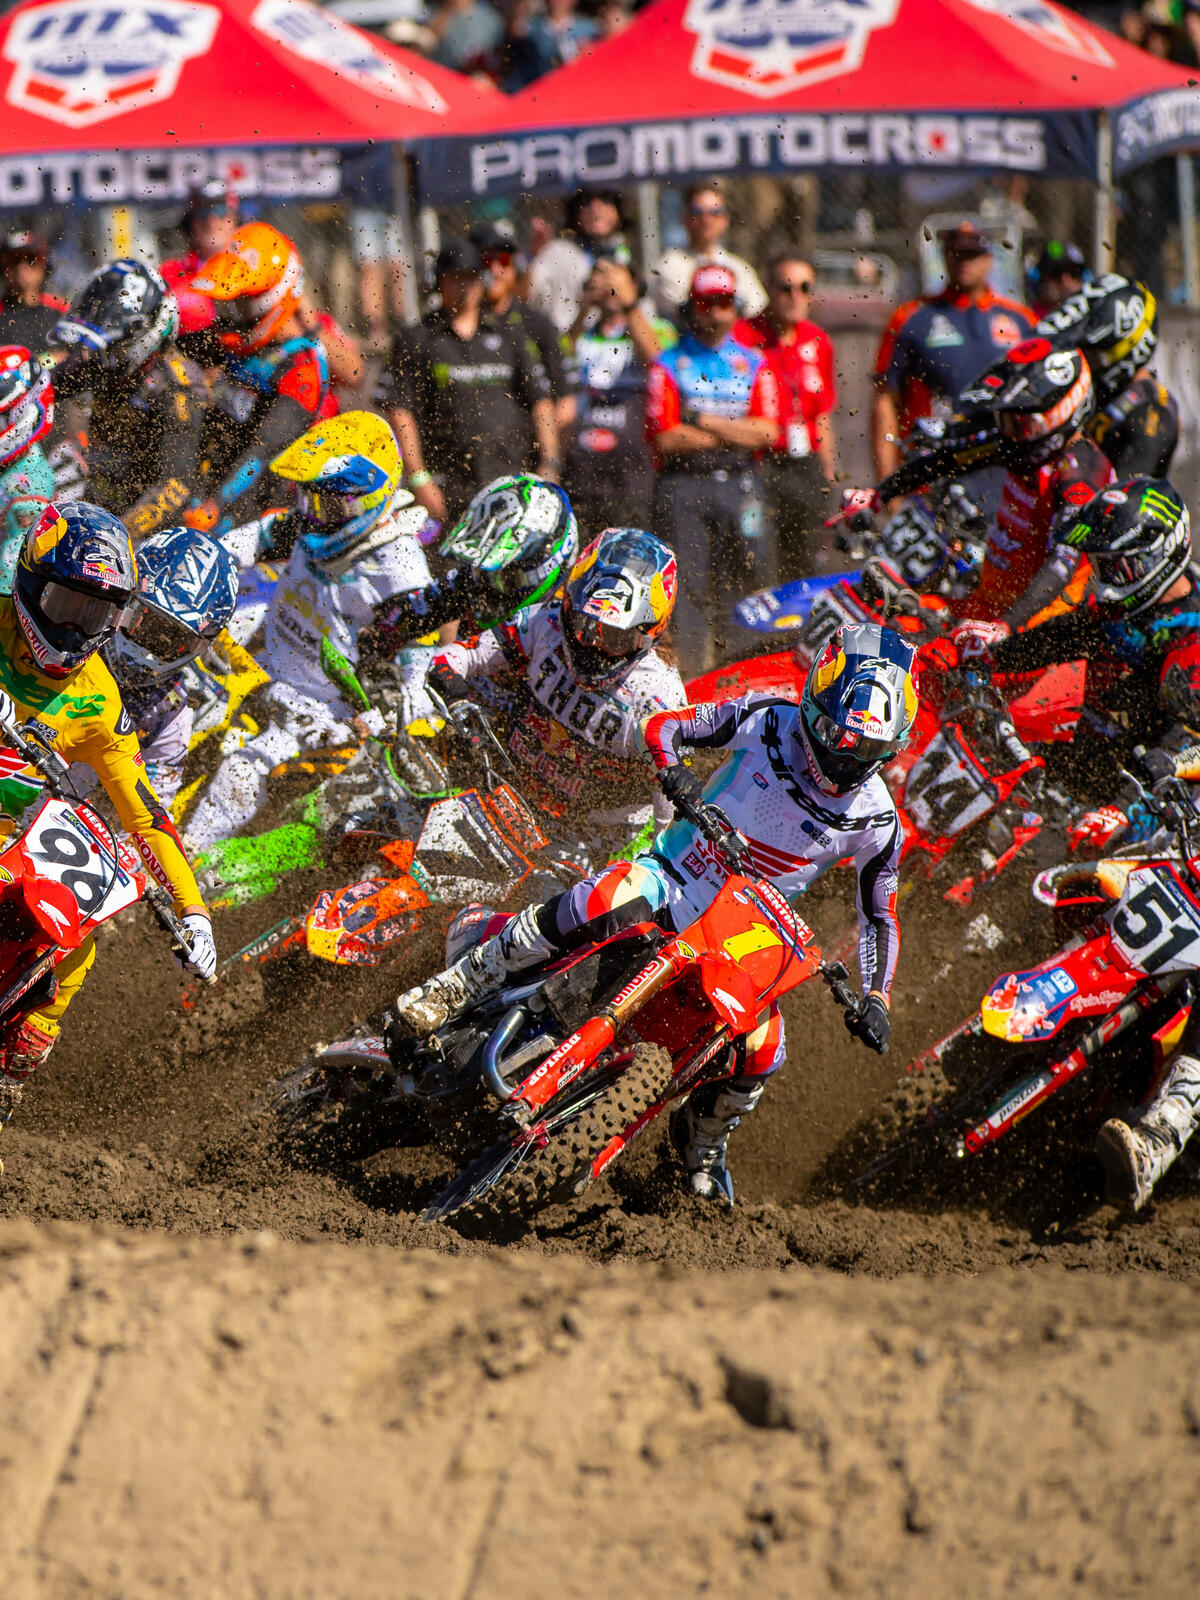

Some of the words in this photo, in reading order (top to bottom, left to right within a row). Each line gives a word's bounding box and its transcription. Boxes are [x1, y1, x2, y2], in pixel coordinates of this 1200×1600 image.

[469, 113, 1046, 193] PROMOTOCROSS
[533, 652, 623, 748] THOR
[846, 717, 865, 730] Red
[864, 721, 884, 735] Bull
[82, 807, 132, 867] RENTHAL
[132, 831, 177, 900] HONDA
[39, 827, 104, 913] 96
[722, 921, 784, 964] 1
[1112, 880, 1199, 974] 51
[528, 1033, 582, 1086] DUNLOP
[998, 1078, 1042, 1122] DUNLOP
